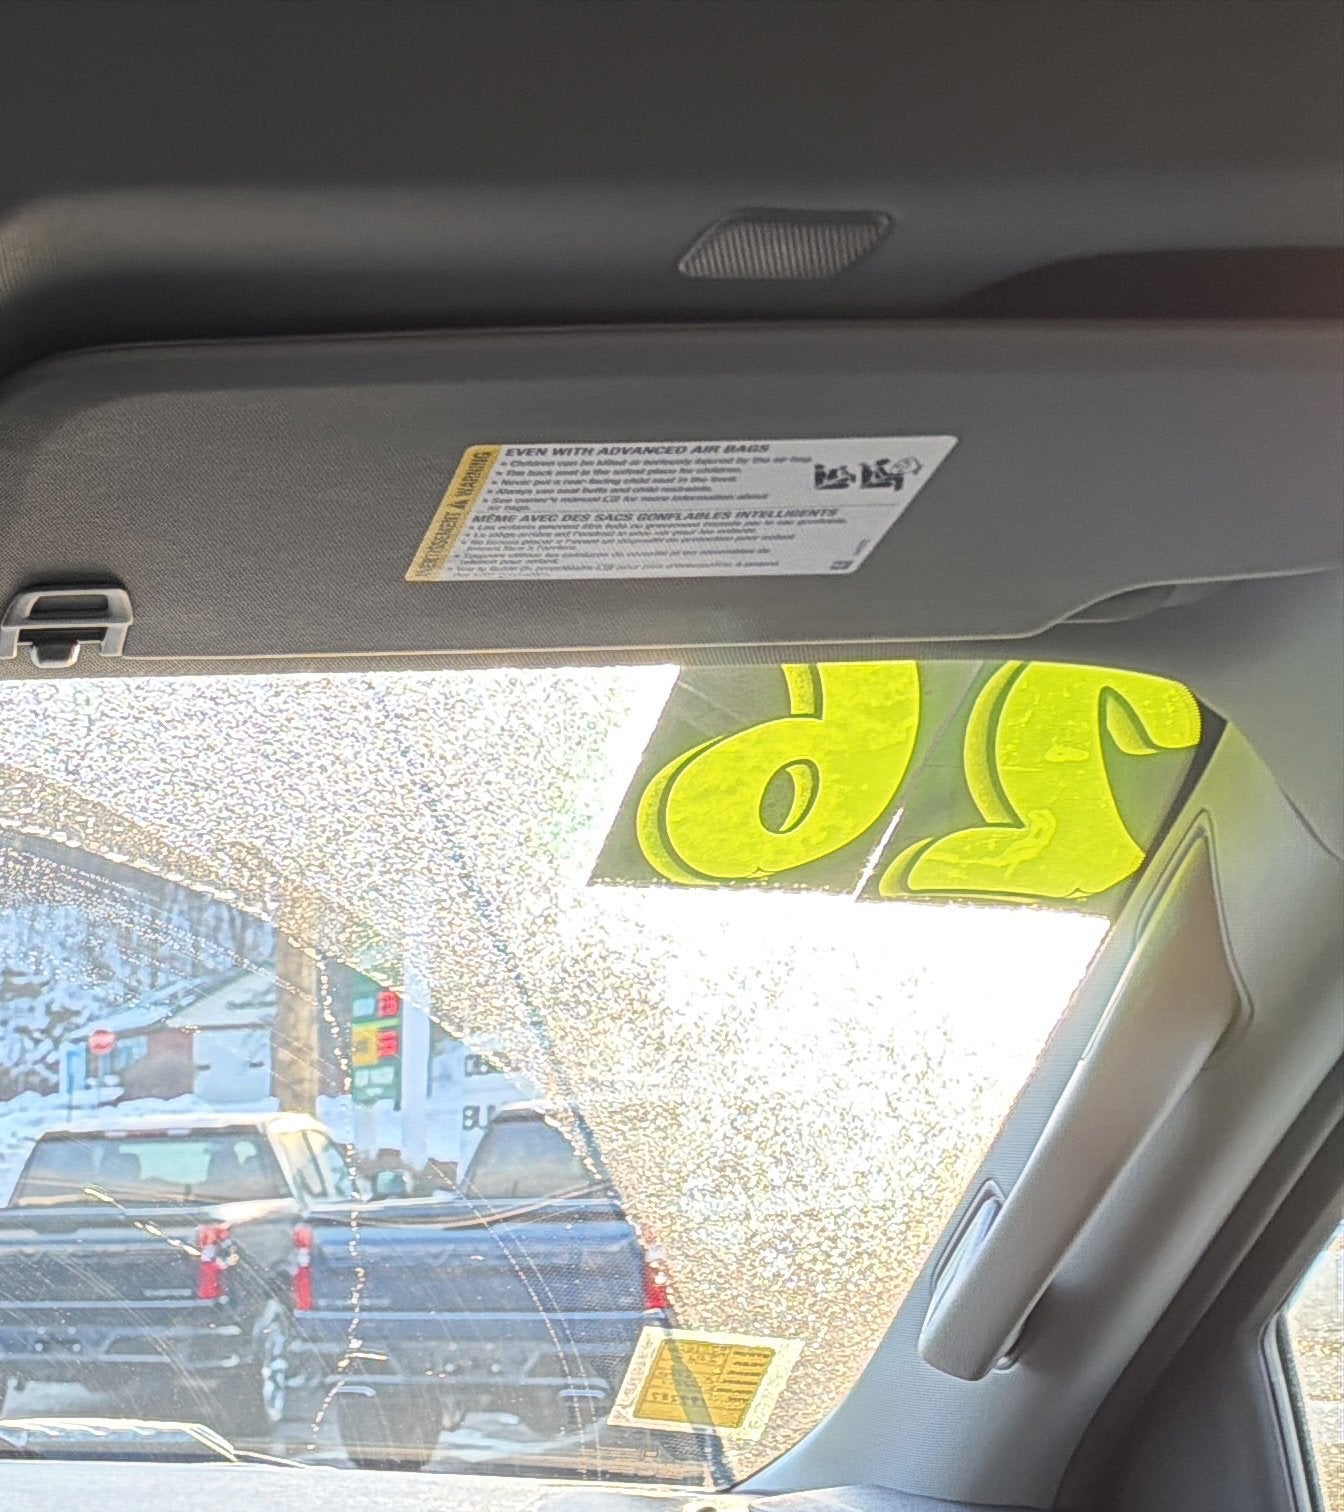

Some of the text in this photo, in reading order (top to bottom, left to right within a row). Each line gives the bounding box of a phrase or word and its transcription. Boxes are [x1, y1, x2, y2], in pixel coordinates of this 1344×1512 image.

[505, 444, 769, 457] EVEN WITH ADVANCED AIR BAGS
